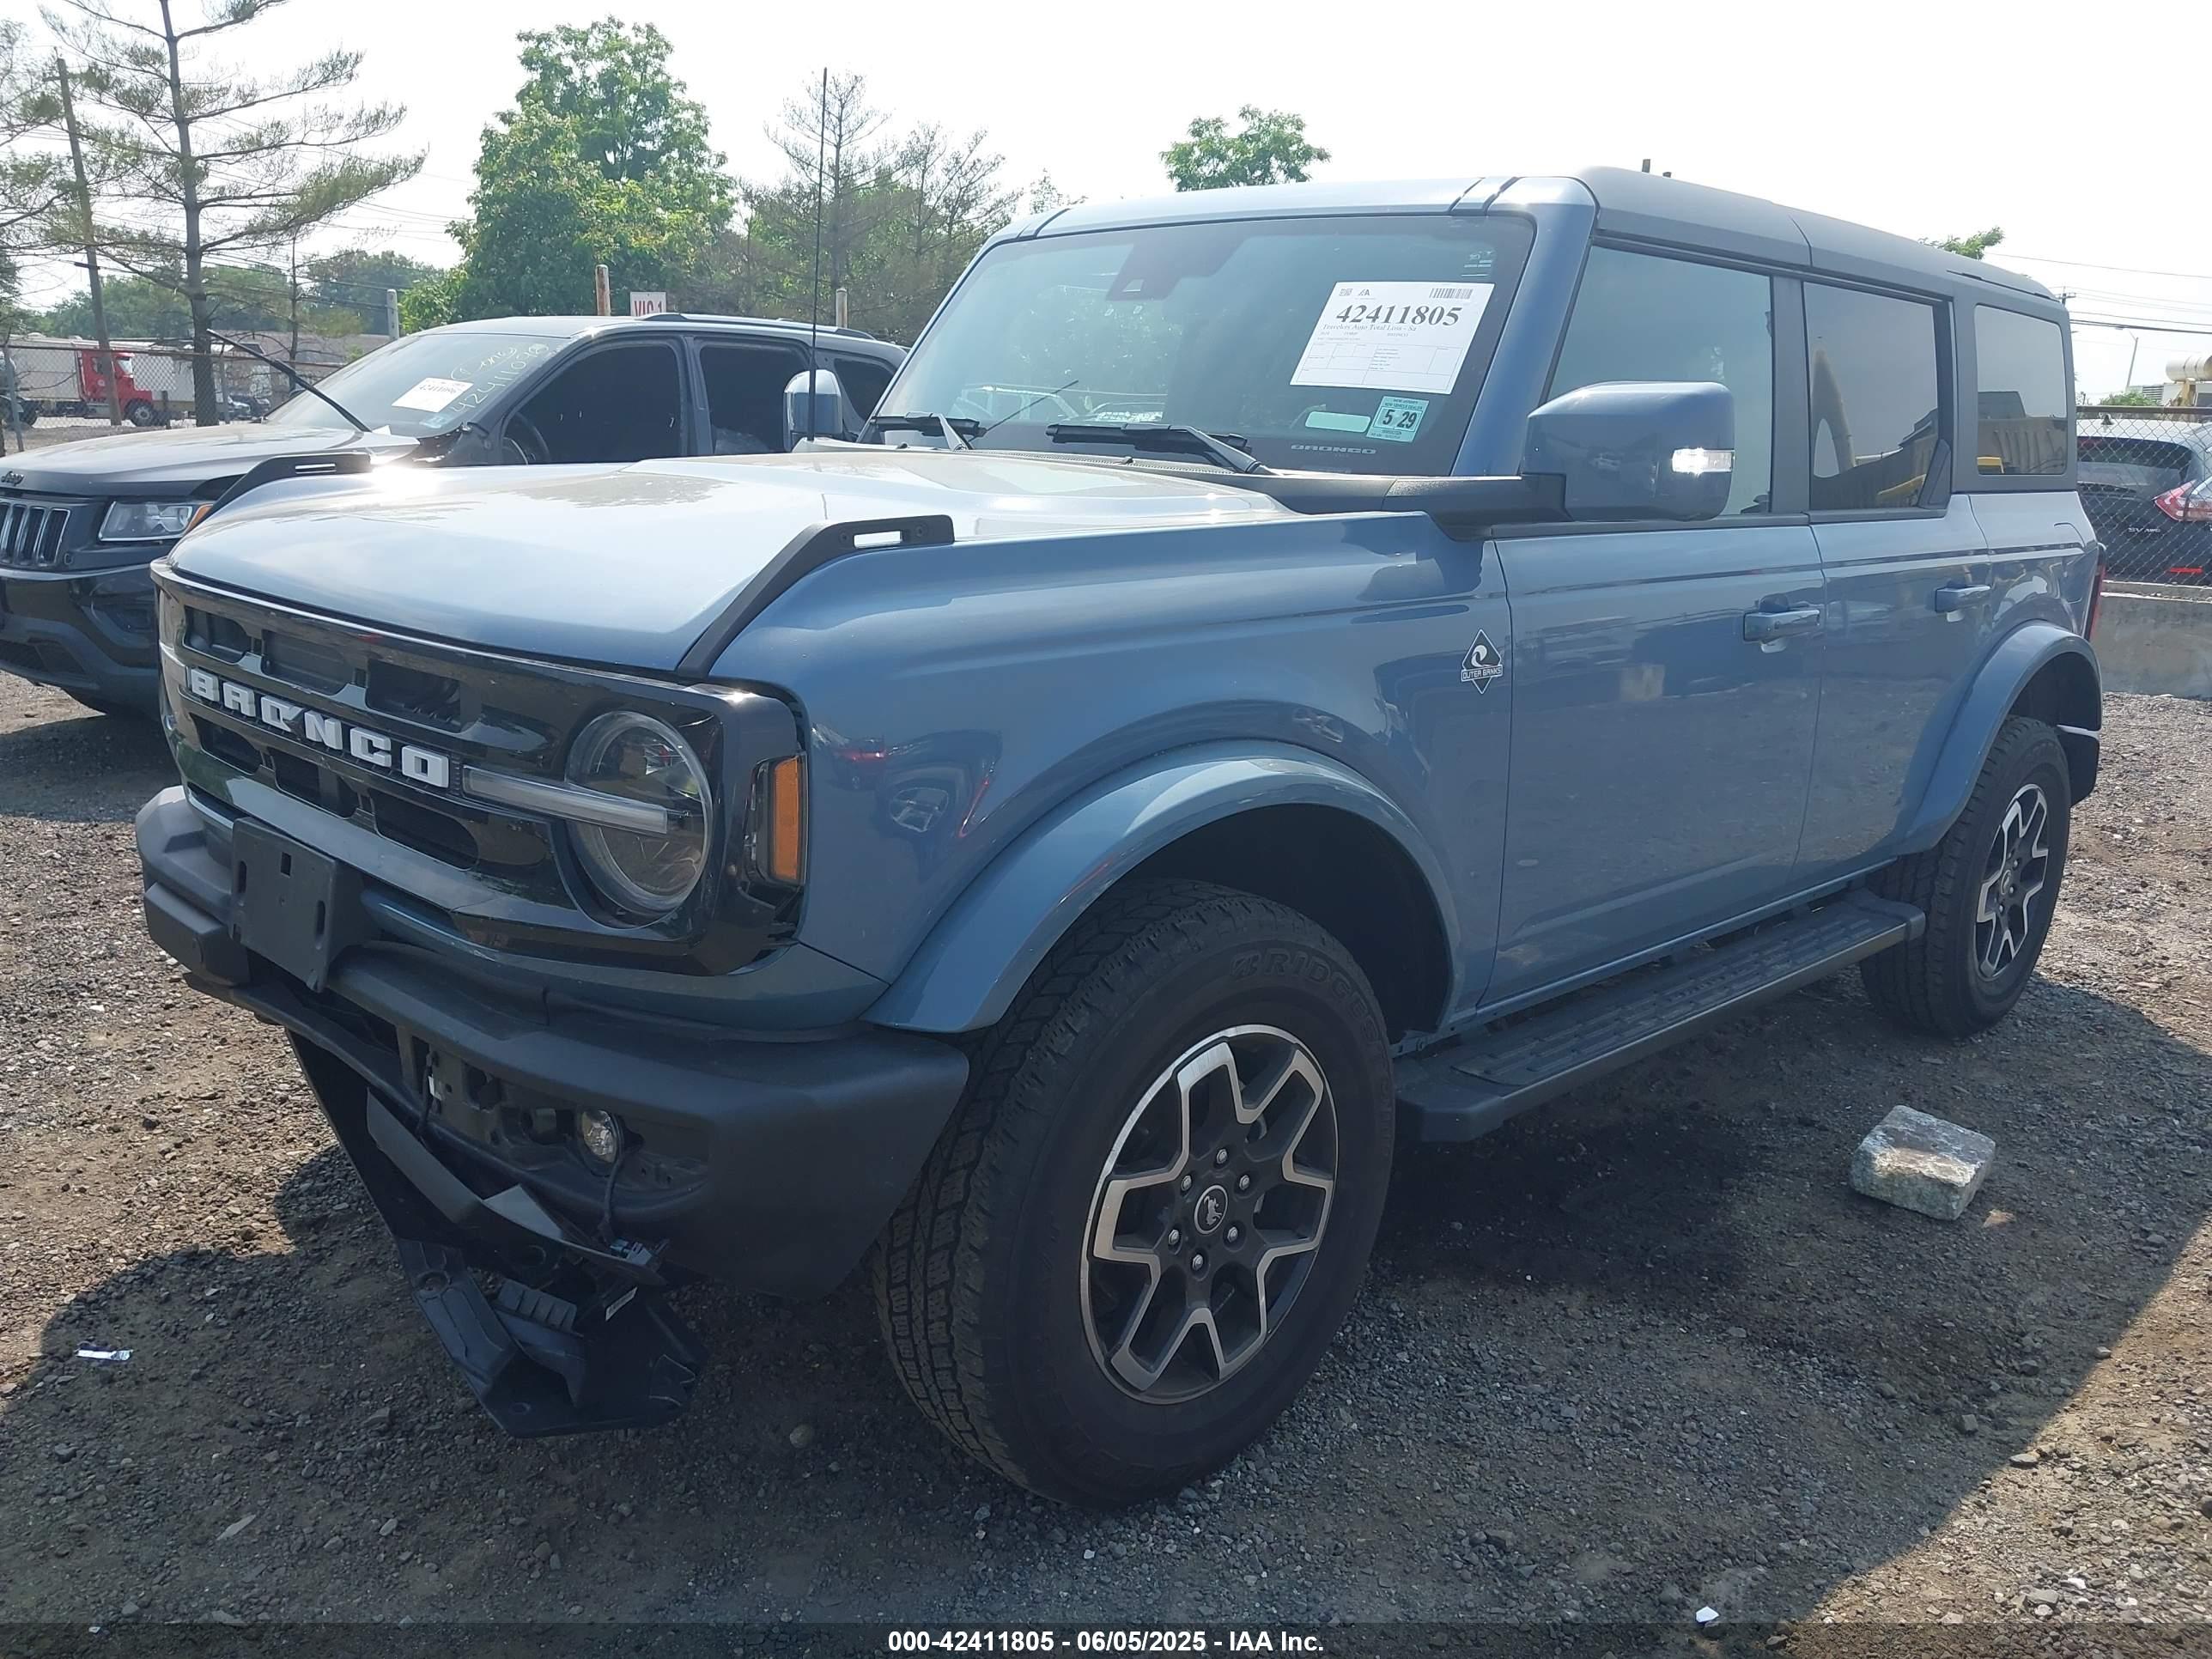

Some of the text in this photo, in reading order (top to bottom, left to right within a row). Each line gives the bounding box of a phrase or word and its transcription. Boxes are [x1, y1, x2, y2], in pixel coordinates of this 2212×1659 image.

[1336, 304, 1462, 325] 42411805
[1382, 409, 1418, 429] 5 29
[1462, 667, 1501, 679] OUTER BANKS
[191, 667, 450, 789] BRONCO
